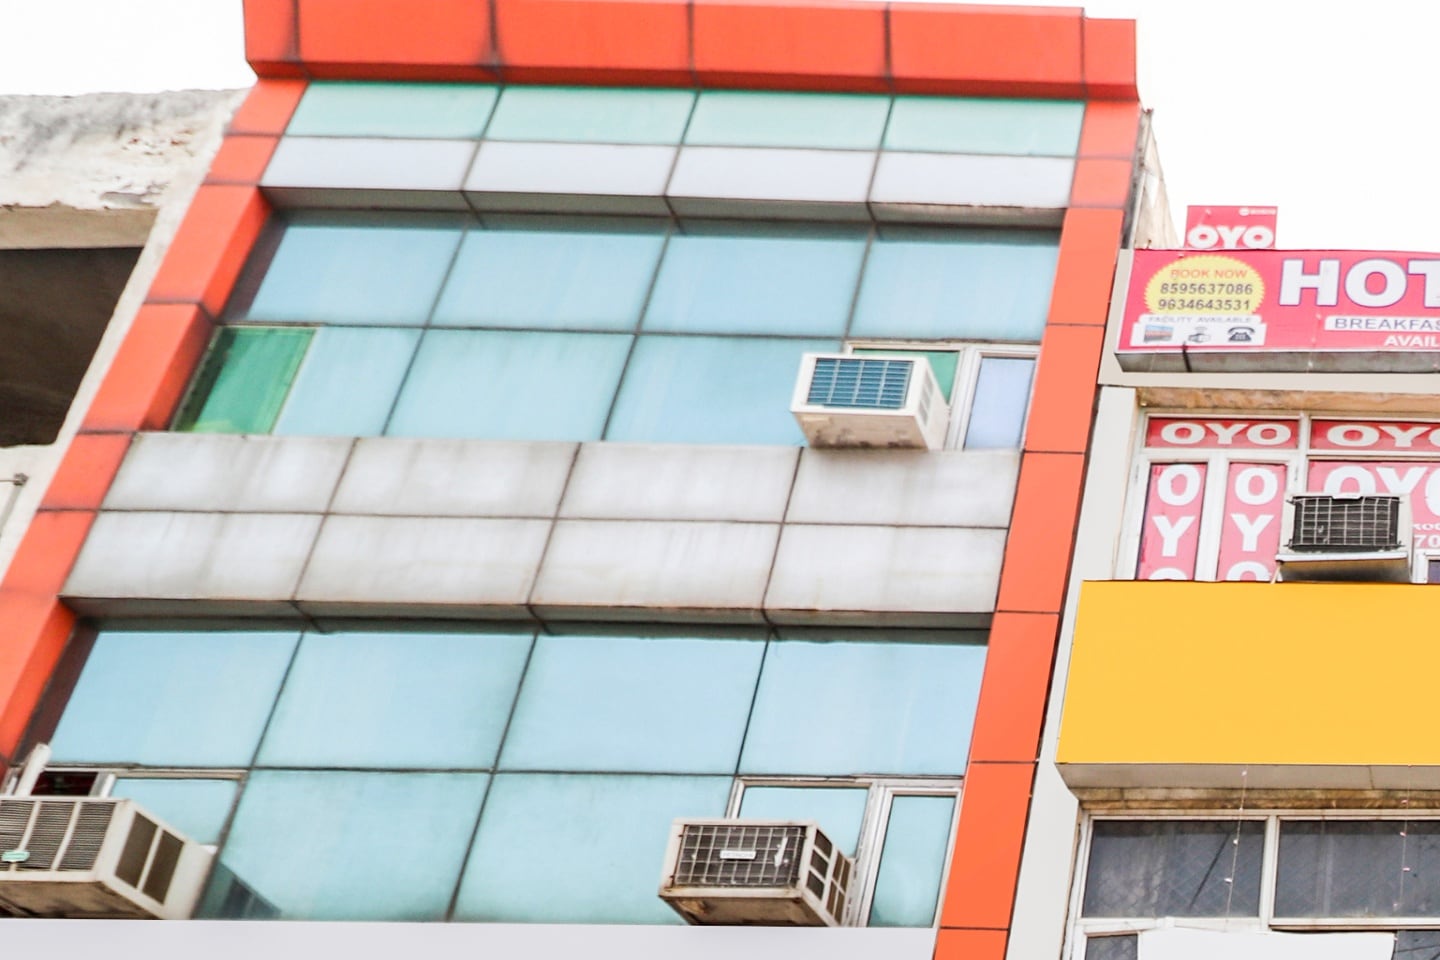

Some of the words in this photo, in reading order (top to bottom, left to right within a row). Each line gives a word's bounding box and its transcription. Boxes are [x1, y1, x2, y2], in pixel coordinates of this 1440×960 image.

[1187, 225, 1274, 249] OYO
[1171, 269, 1209, 279] BOOK
[1215, 269, 1249, 279] NOW
[1160, 283, 1253, 295] 8595637086
[1157, 299, 1251, 311] 9634643531
[1160, 422, 1292, 445] OYO
